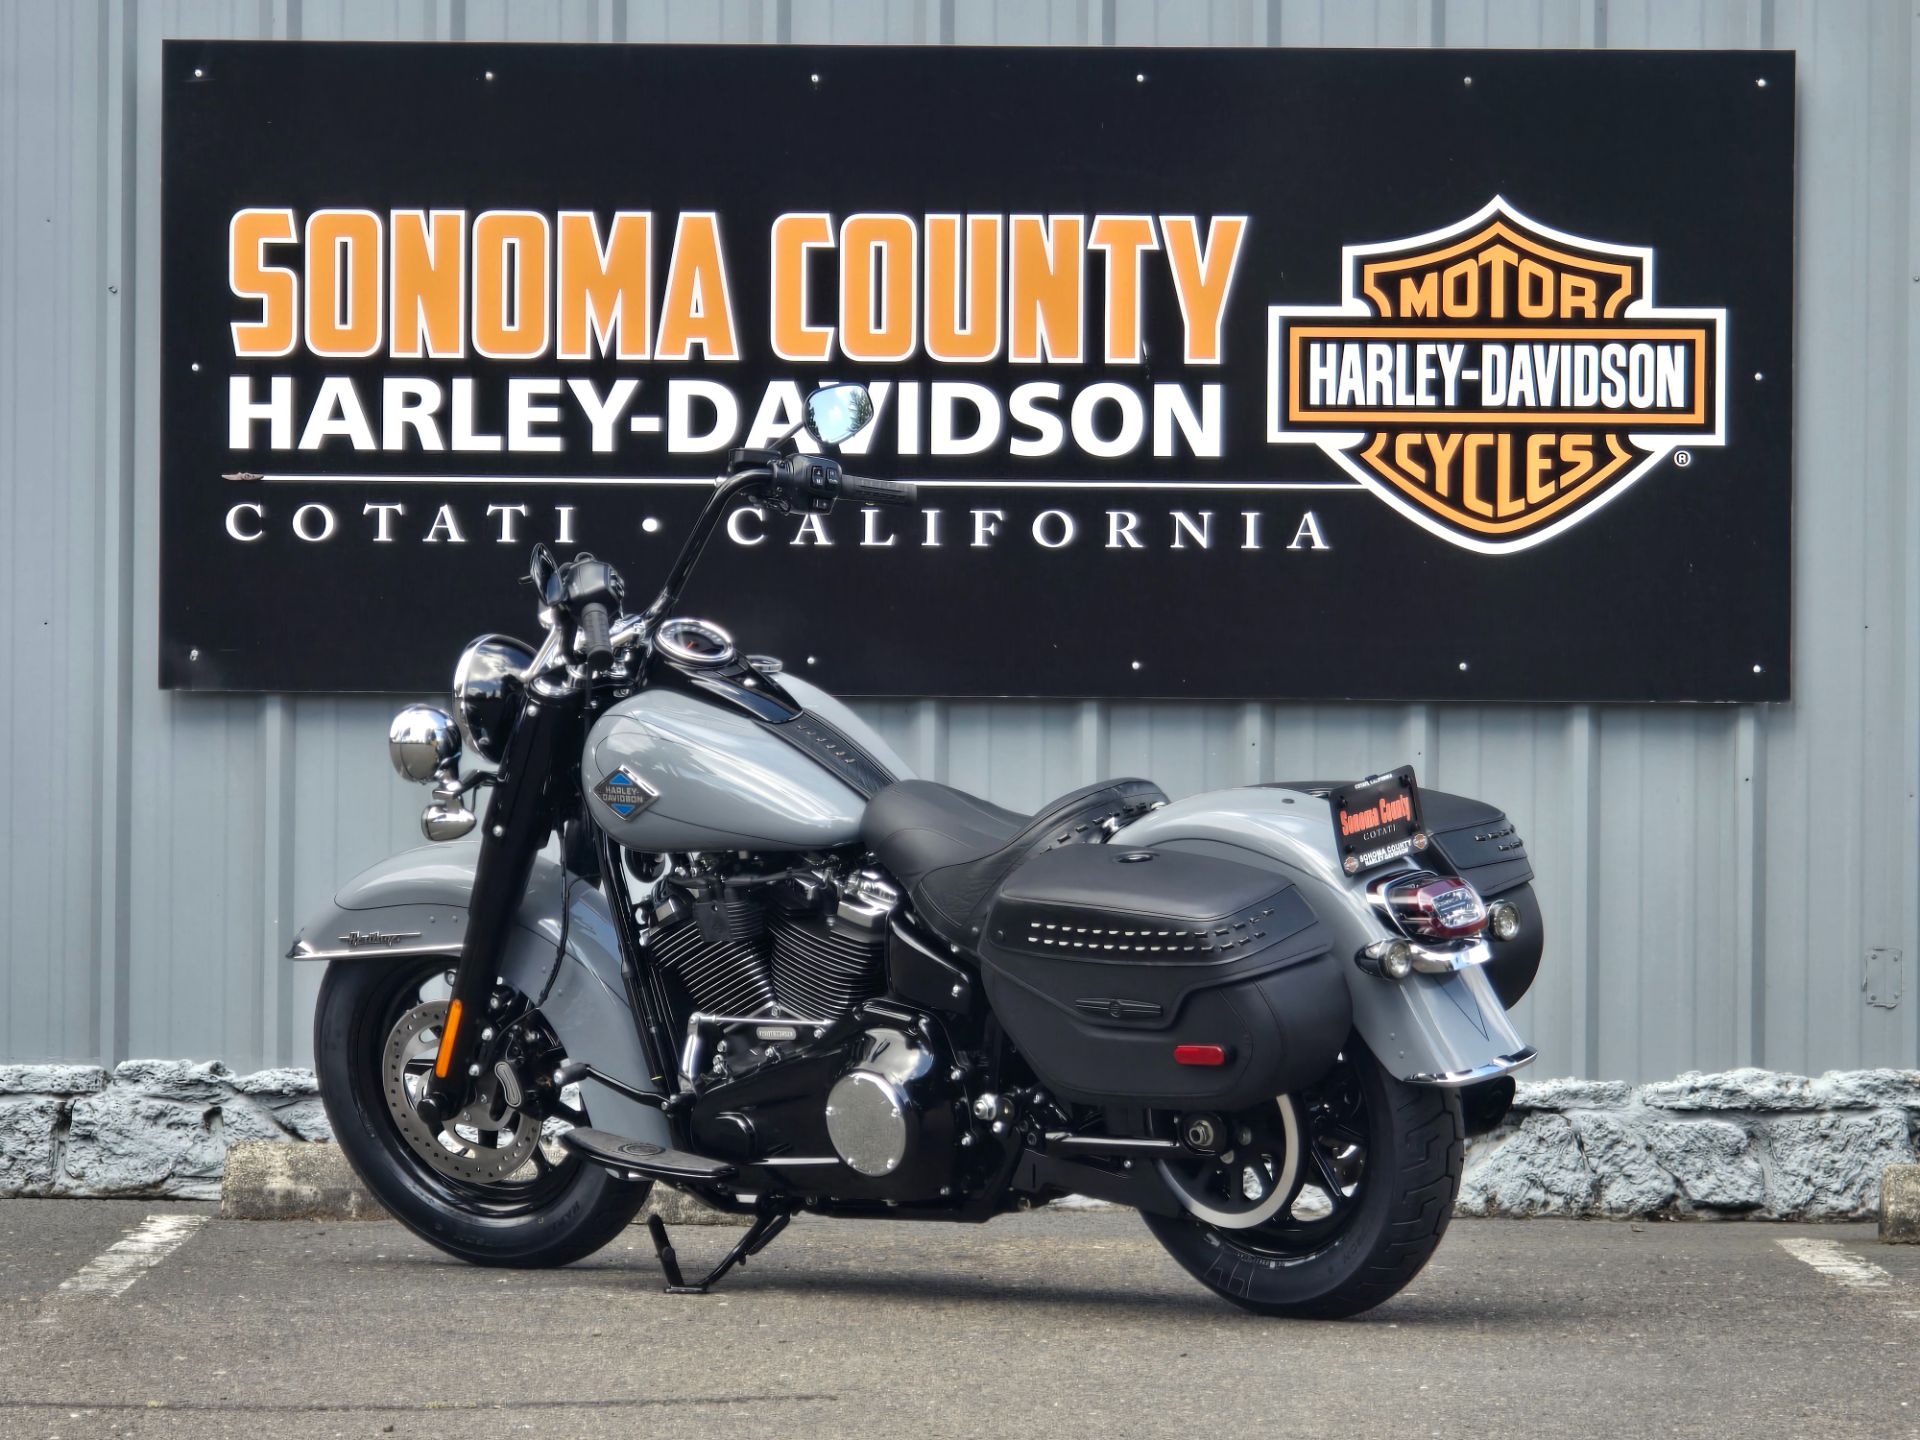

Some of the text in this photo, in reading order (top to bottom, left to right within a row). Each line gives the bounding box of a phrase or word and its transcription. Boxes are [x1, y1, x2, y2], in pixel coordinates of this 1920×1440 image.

[229, 208, 1249, 364] SONOMA COUNTY
[1400, 244, 1597, 319] MOTOR
[1309, 342, 1686, 408] HARLEY-DAVIDSON
[229, 377, 1221, 458] HARLEY-DAVIDSON
[1395, 433, 1594, 518] CYCLES
[226, 504, 1331, 550] COTATI CALIFORNIA
[1340, 795, 1410, 836] Sonoma County
[1363, 824, 1396, 840] COTATI
[1359, 848, 1387, 863] SONOMA
[1386, 839, 1412, 853] COUNTY
